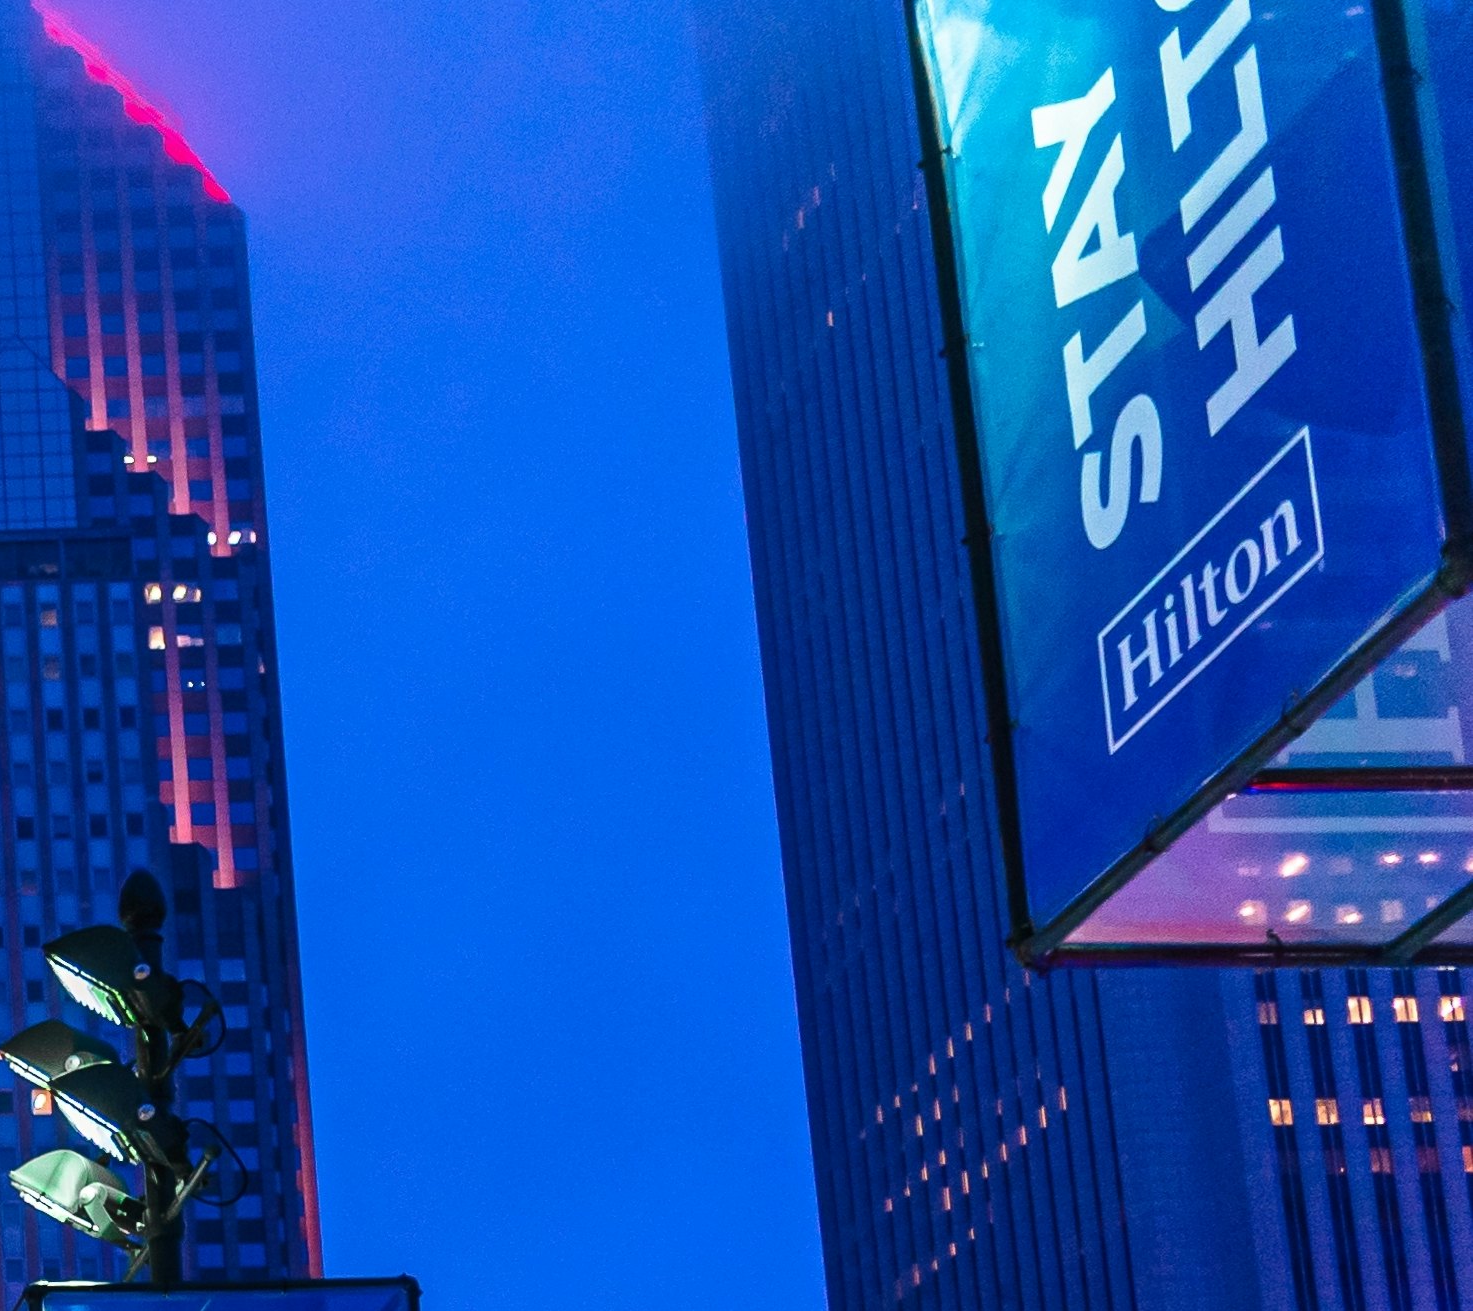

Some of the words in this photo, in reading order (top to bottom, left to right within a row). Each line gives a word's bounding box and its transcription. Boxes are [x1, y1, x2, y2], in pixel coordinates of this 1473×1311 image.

[1032, 67, 1163, 550] STAY
[1159, 0, 1298, 437] HILT
[1117, 499, 1301, 713] Hilton
